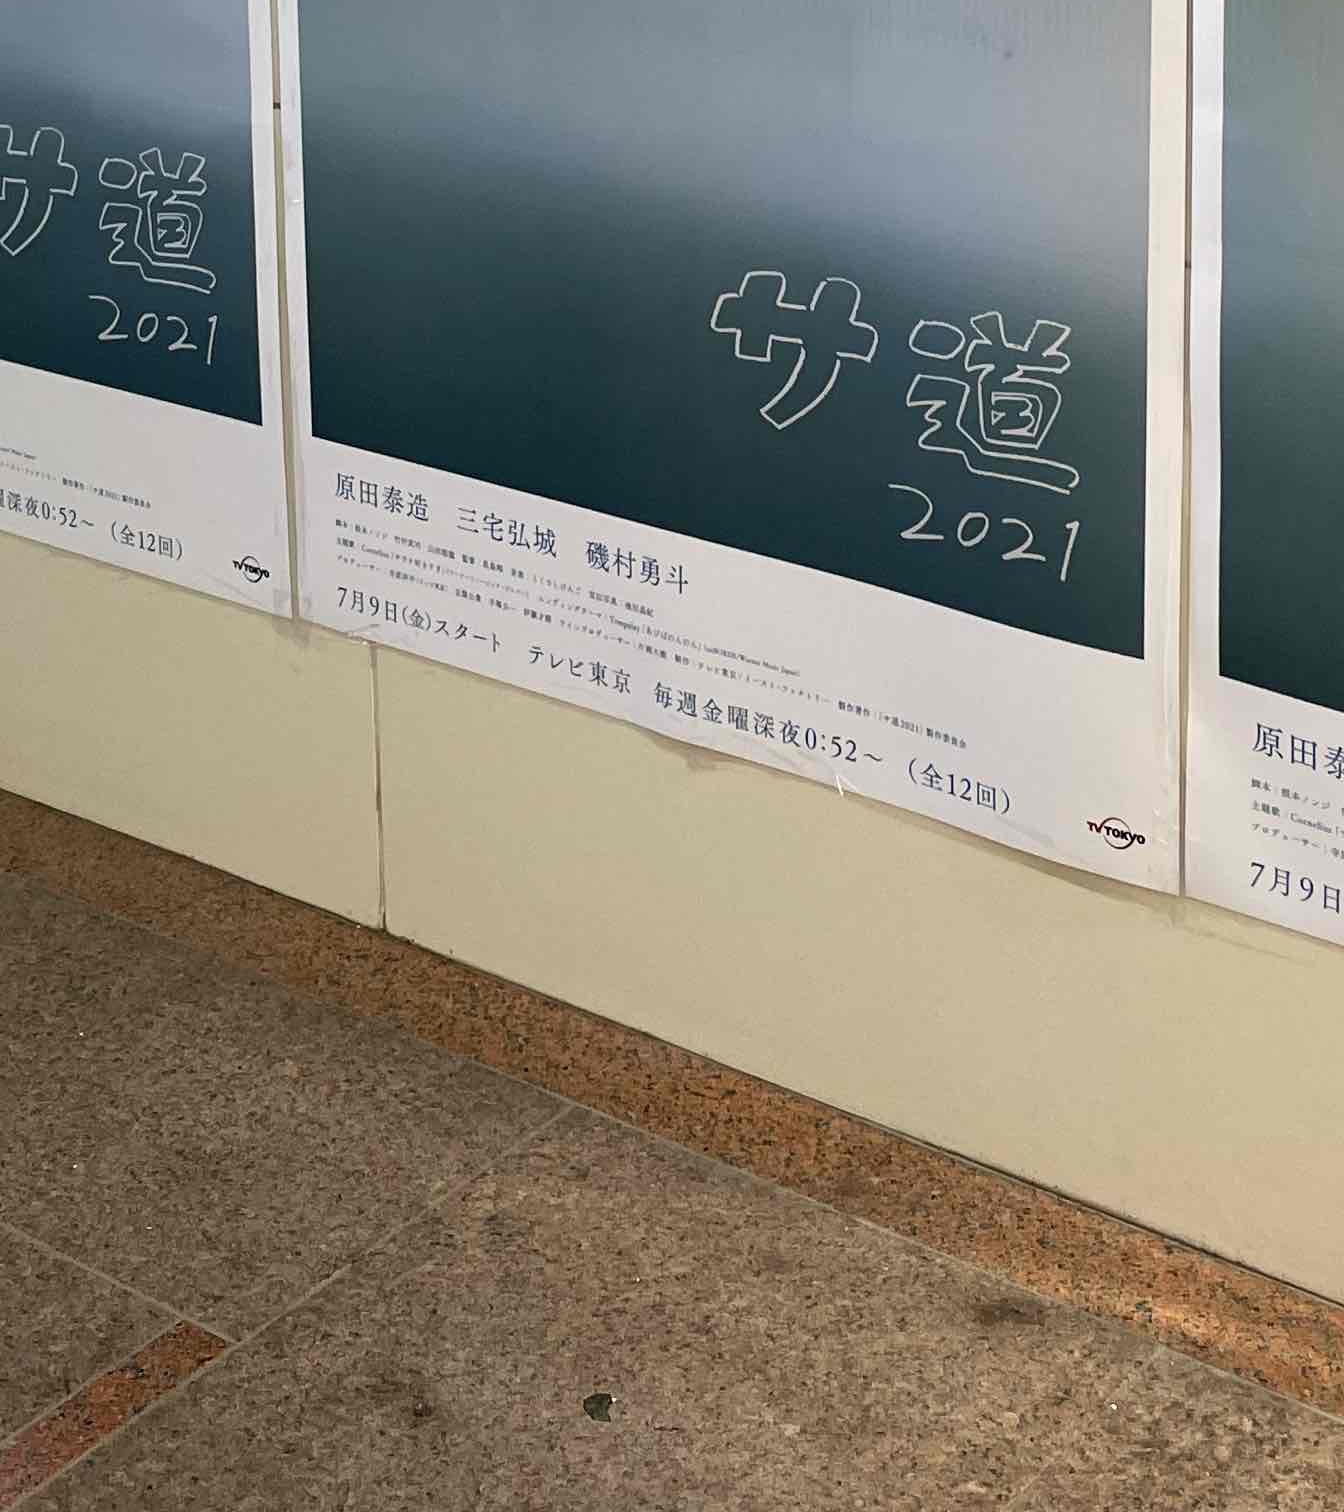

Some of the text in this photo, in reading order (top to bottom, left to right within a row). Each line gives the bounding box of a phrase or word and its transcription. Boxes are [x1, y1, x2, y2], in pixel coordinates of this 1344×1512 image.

[88, 295, 217, 365] 2021
[711, 271, 1080, 494] サ道
[335, 472, 428, 521] 原田泰造
[456, 507, 556, 558] 三宅弘城
[585, 540, 688, 594] 磯村勇斗
[889, 484, 1079, 581] 2021
[528, 645, 630, 694] テレビ東京
